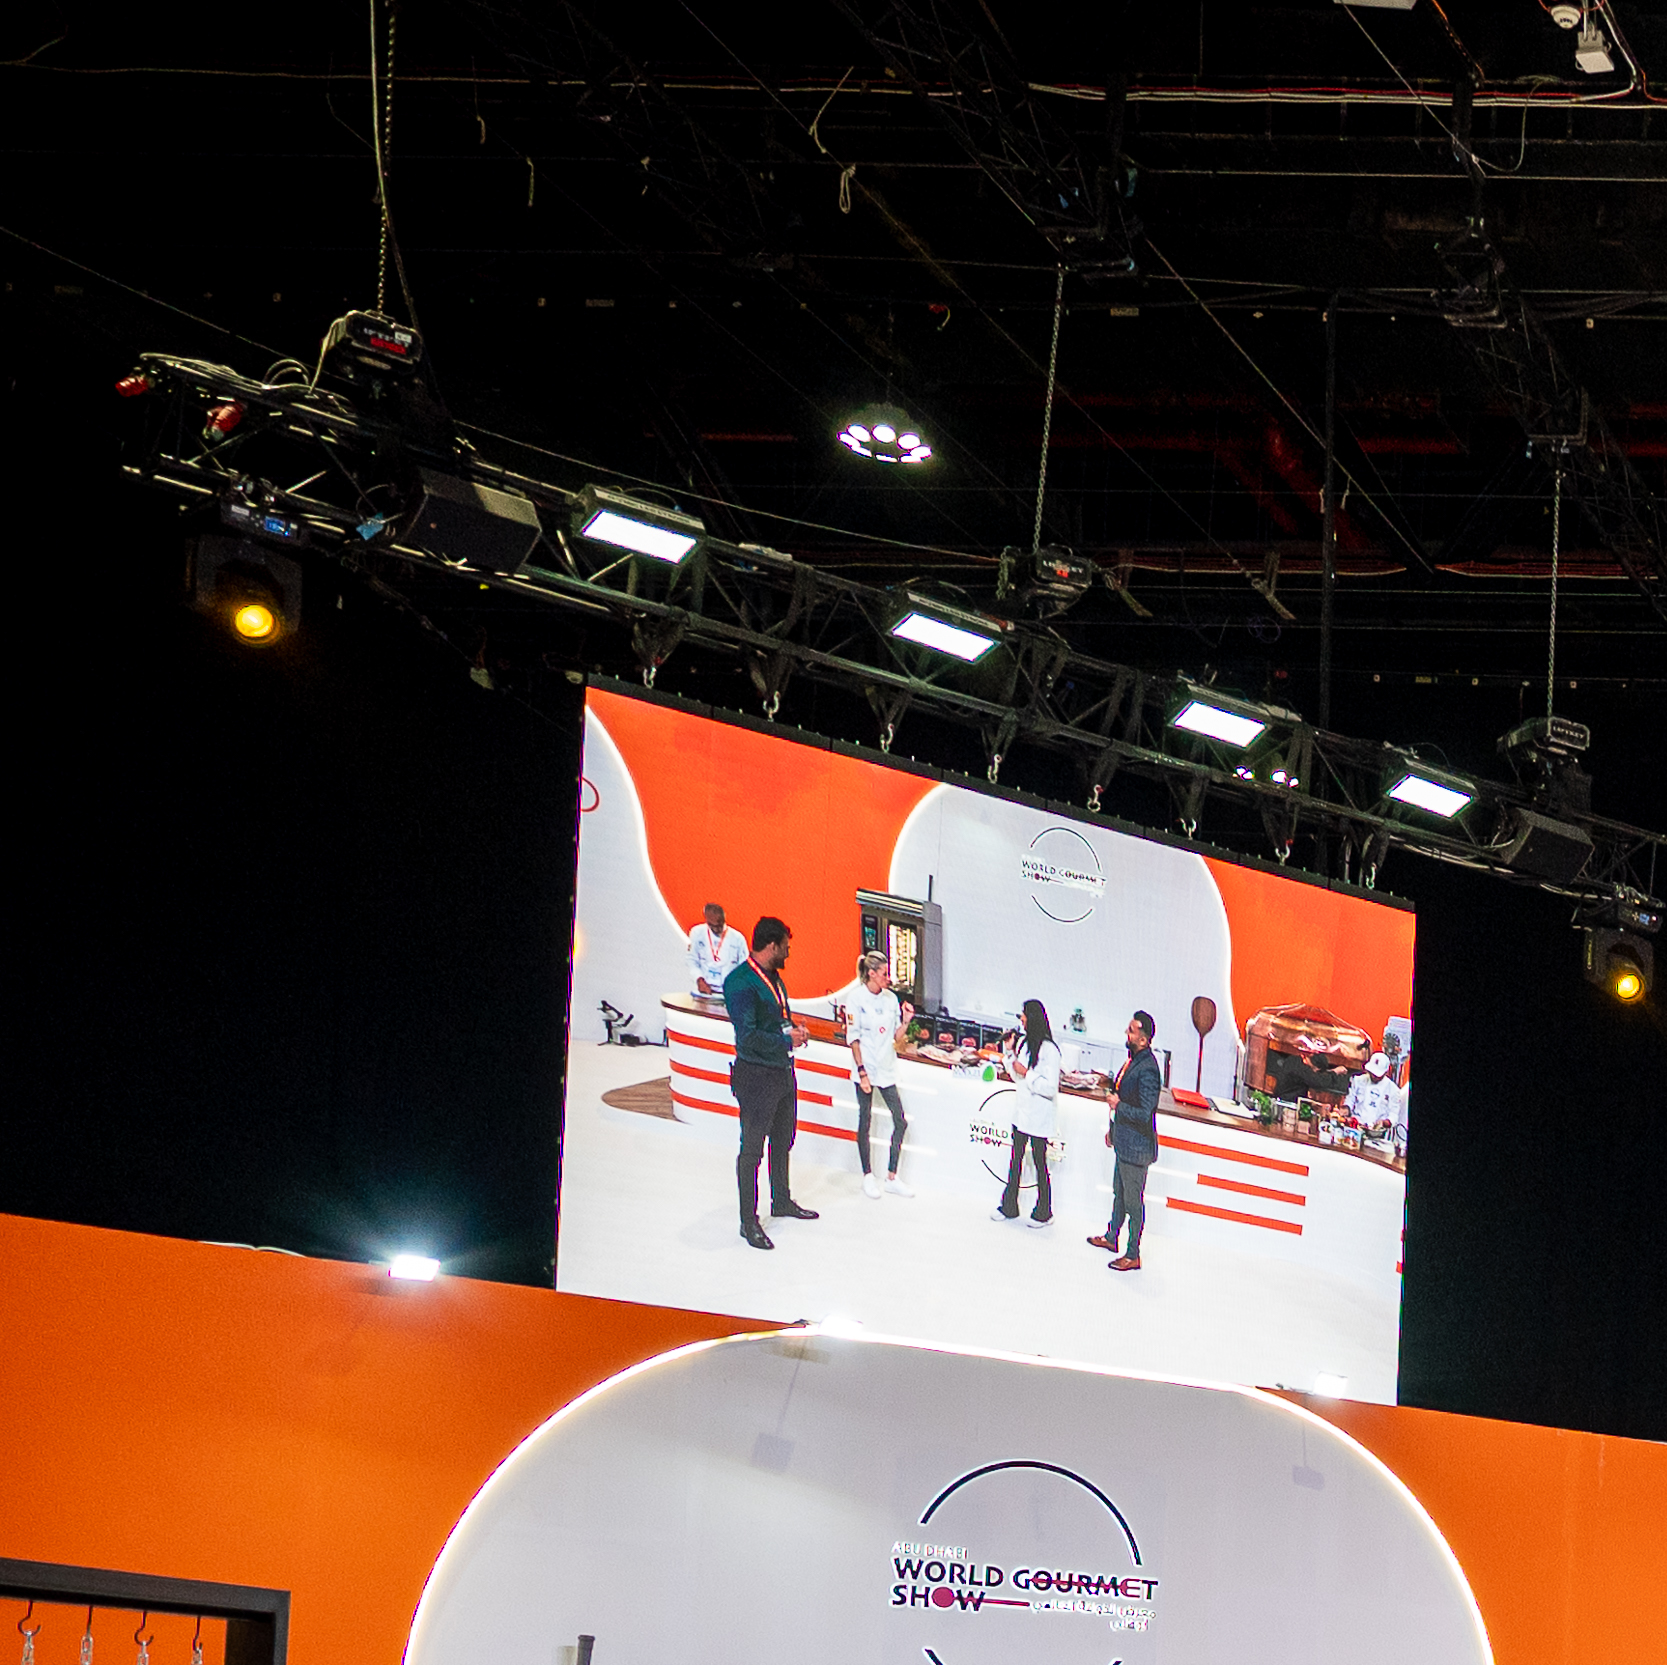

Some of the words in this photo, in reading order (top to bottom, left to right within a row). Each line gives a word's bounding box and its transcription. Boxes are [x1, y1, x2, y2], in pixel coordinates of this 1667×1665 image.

[1022, 860, 1056, 875] WORLD
[970, 1123, 1009, 1139] WORLD
[891, 1541, 921, 1555] ABU
[924, 1544, 968, 1560] DHABI
[893, 1557, 1004, 1587] WORLD
[1012, 1569, 1159, 1600] GOURMET
[892, 1584, 986, 1612] SHOW
